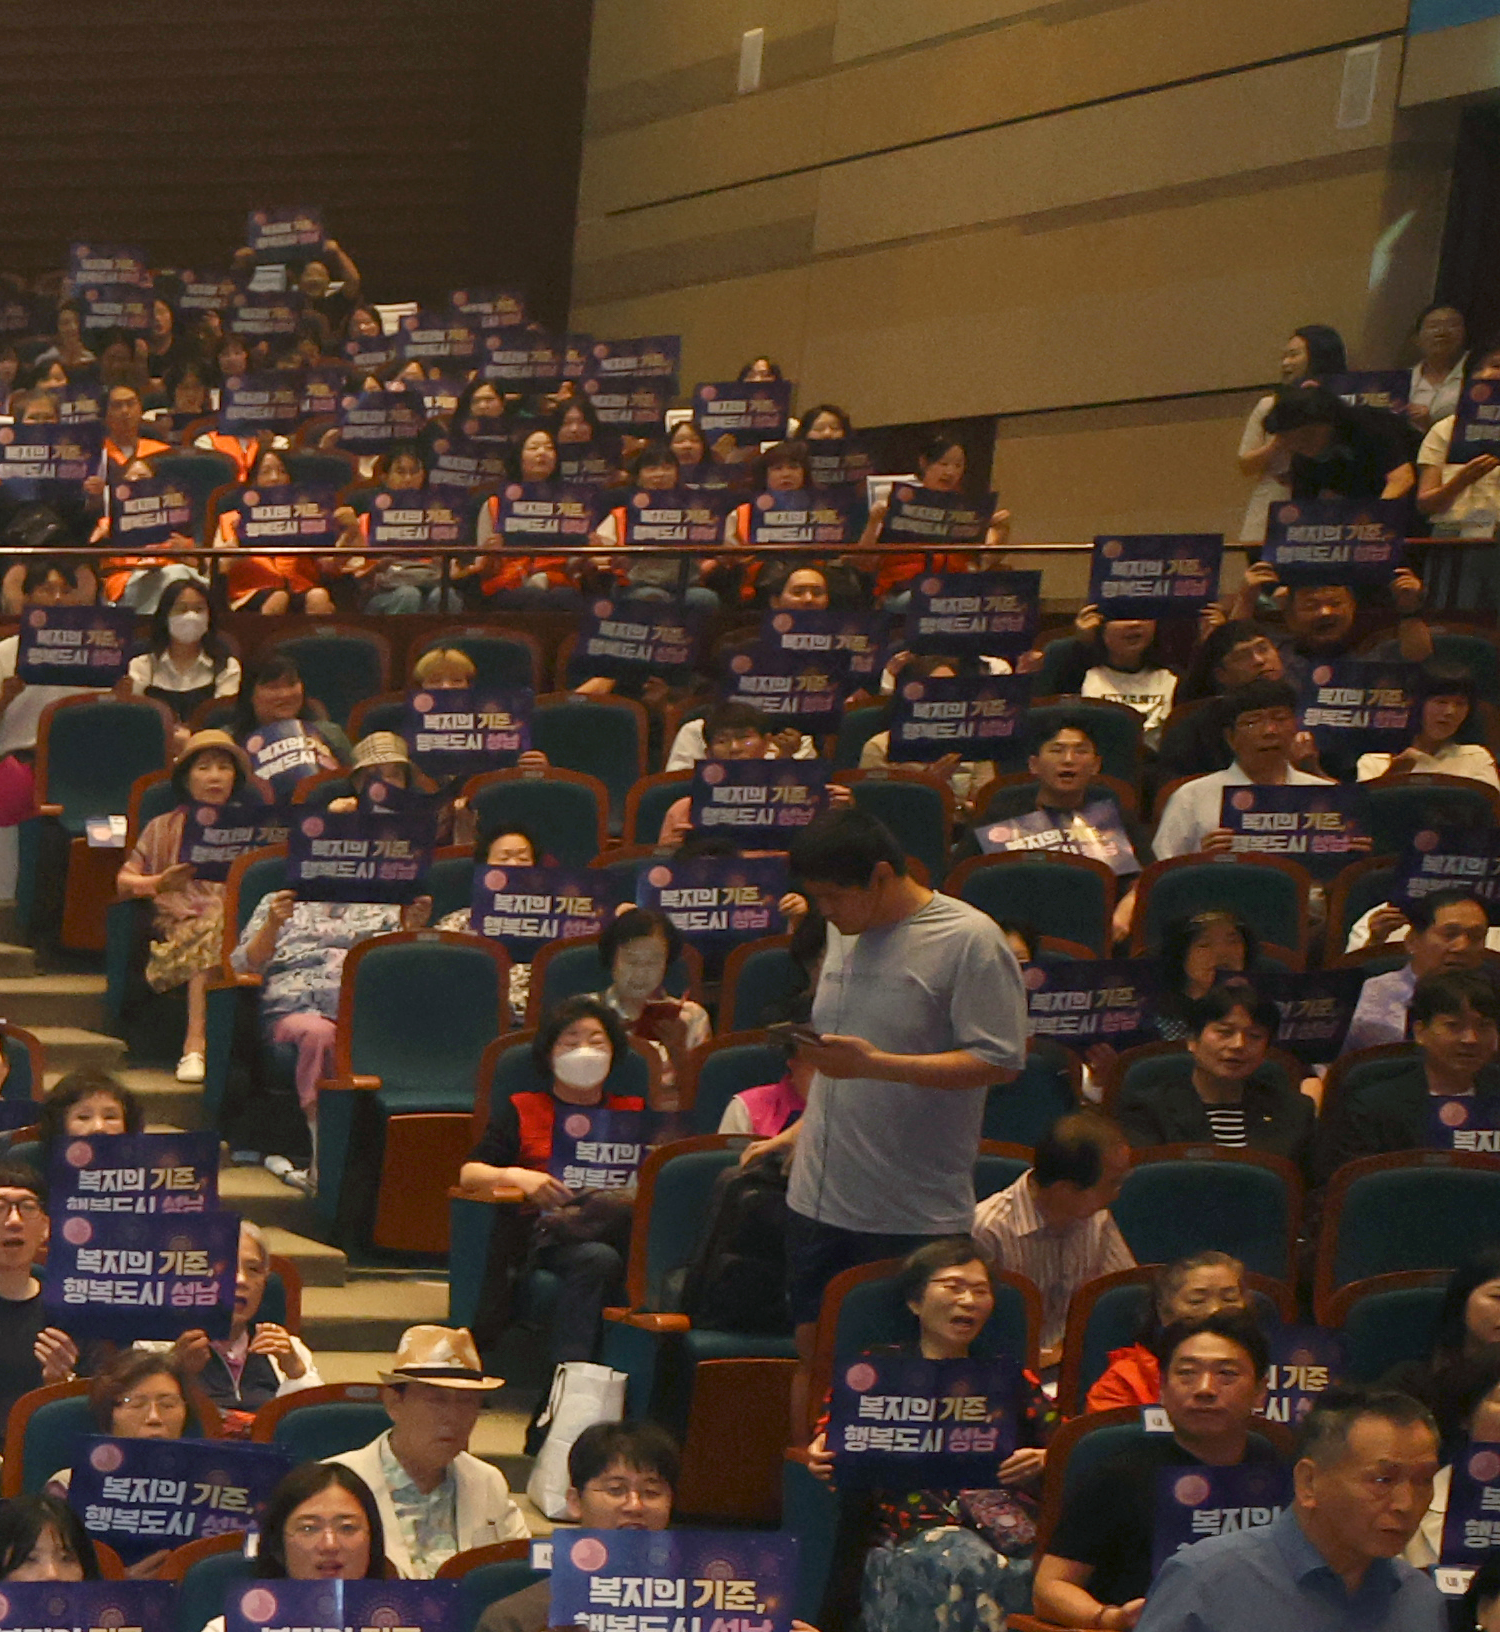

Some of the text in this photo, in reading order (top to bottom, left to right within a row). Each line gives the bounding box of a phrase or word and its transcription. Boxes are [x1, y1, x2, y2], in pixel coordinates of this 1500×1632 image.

[76, 1249, 152, 1275] 복지의
[63, 1279, 163, 1305] 행복도시
[859, 1396, 934, 1421] 복지의
[844, 1426, 943, 1452] 행복도시
[590, 1576, 766, 1614] 복지의 기준,
